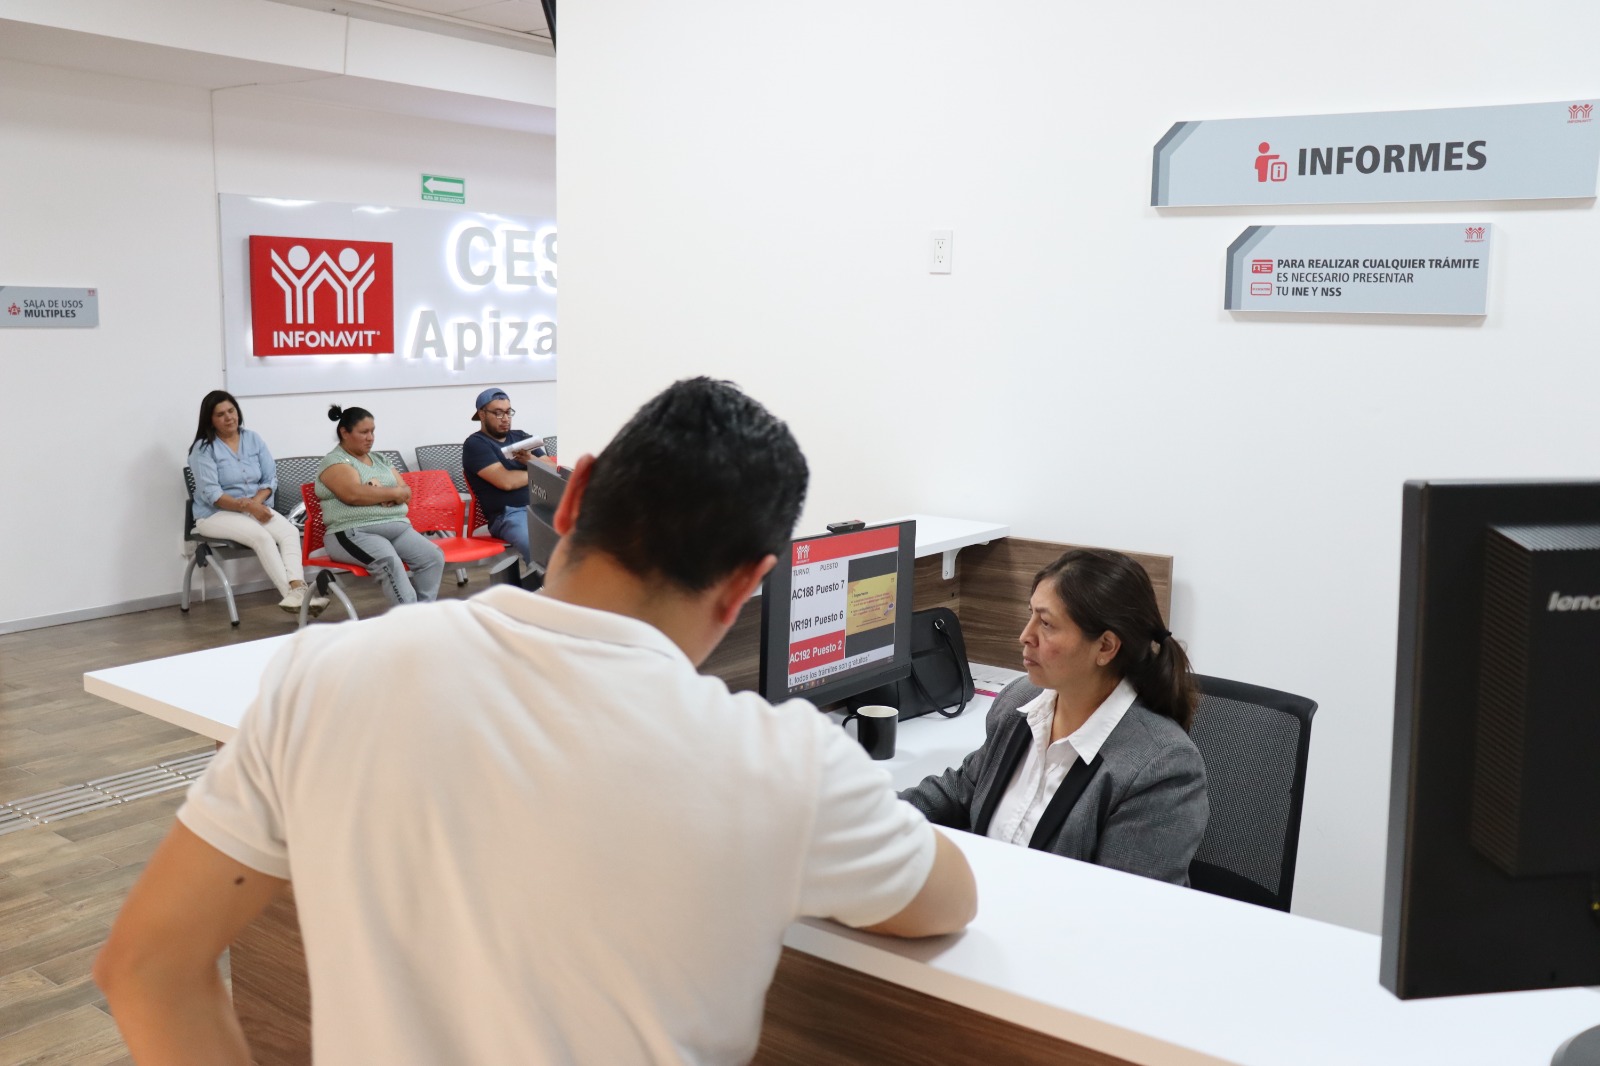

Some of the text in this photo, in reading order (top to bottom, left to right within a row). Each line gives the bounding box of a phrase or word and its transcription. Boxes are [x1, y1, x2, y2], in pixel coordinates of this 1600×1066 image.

[1298, 140, 1487, 176] INFORMES
[1277, 256, 1480, 271] PARA REALIZAR CUALQUIER TRÁMITE
[1276, 272, 1414, 283] ES NECESARIO PRESENTAR
[1276, 286, 1342, 297] TU INE Y NSS
[23, 299, 84, 309] SALA DE USOS
[272, 330, 378, 348] INFONAVIT
[793, 567, 810, 577] TURNO
[819, 561, 839, 571] PUESTO
[791, 585, 814, 601] AC188
[815, 582, 840, 595] Puesto
[840, 579, 845, 590] 7
[790, 617, 812, 632] VR191
[814, 612, 838, 626] Puesto
[839, 609, 844, 620] 6
[789, 639, 843, 664] AC192 Puesto 2
[809, 671, 818, 679] los
[838, 662, 848, 671] son
